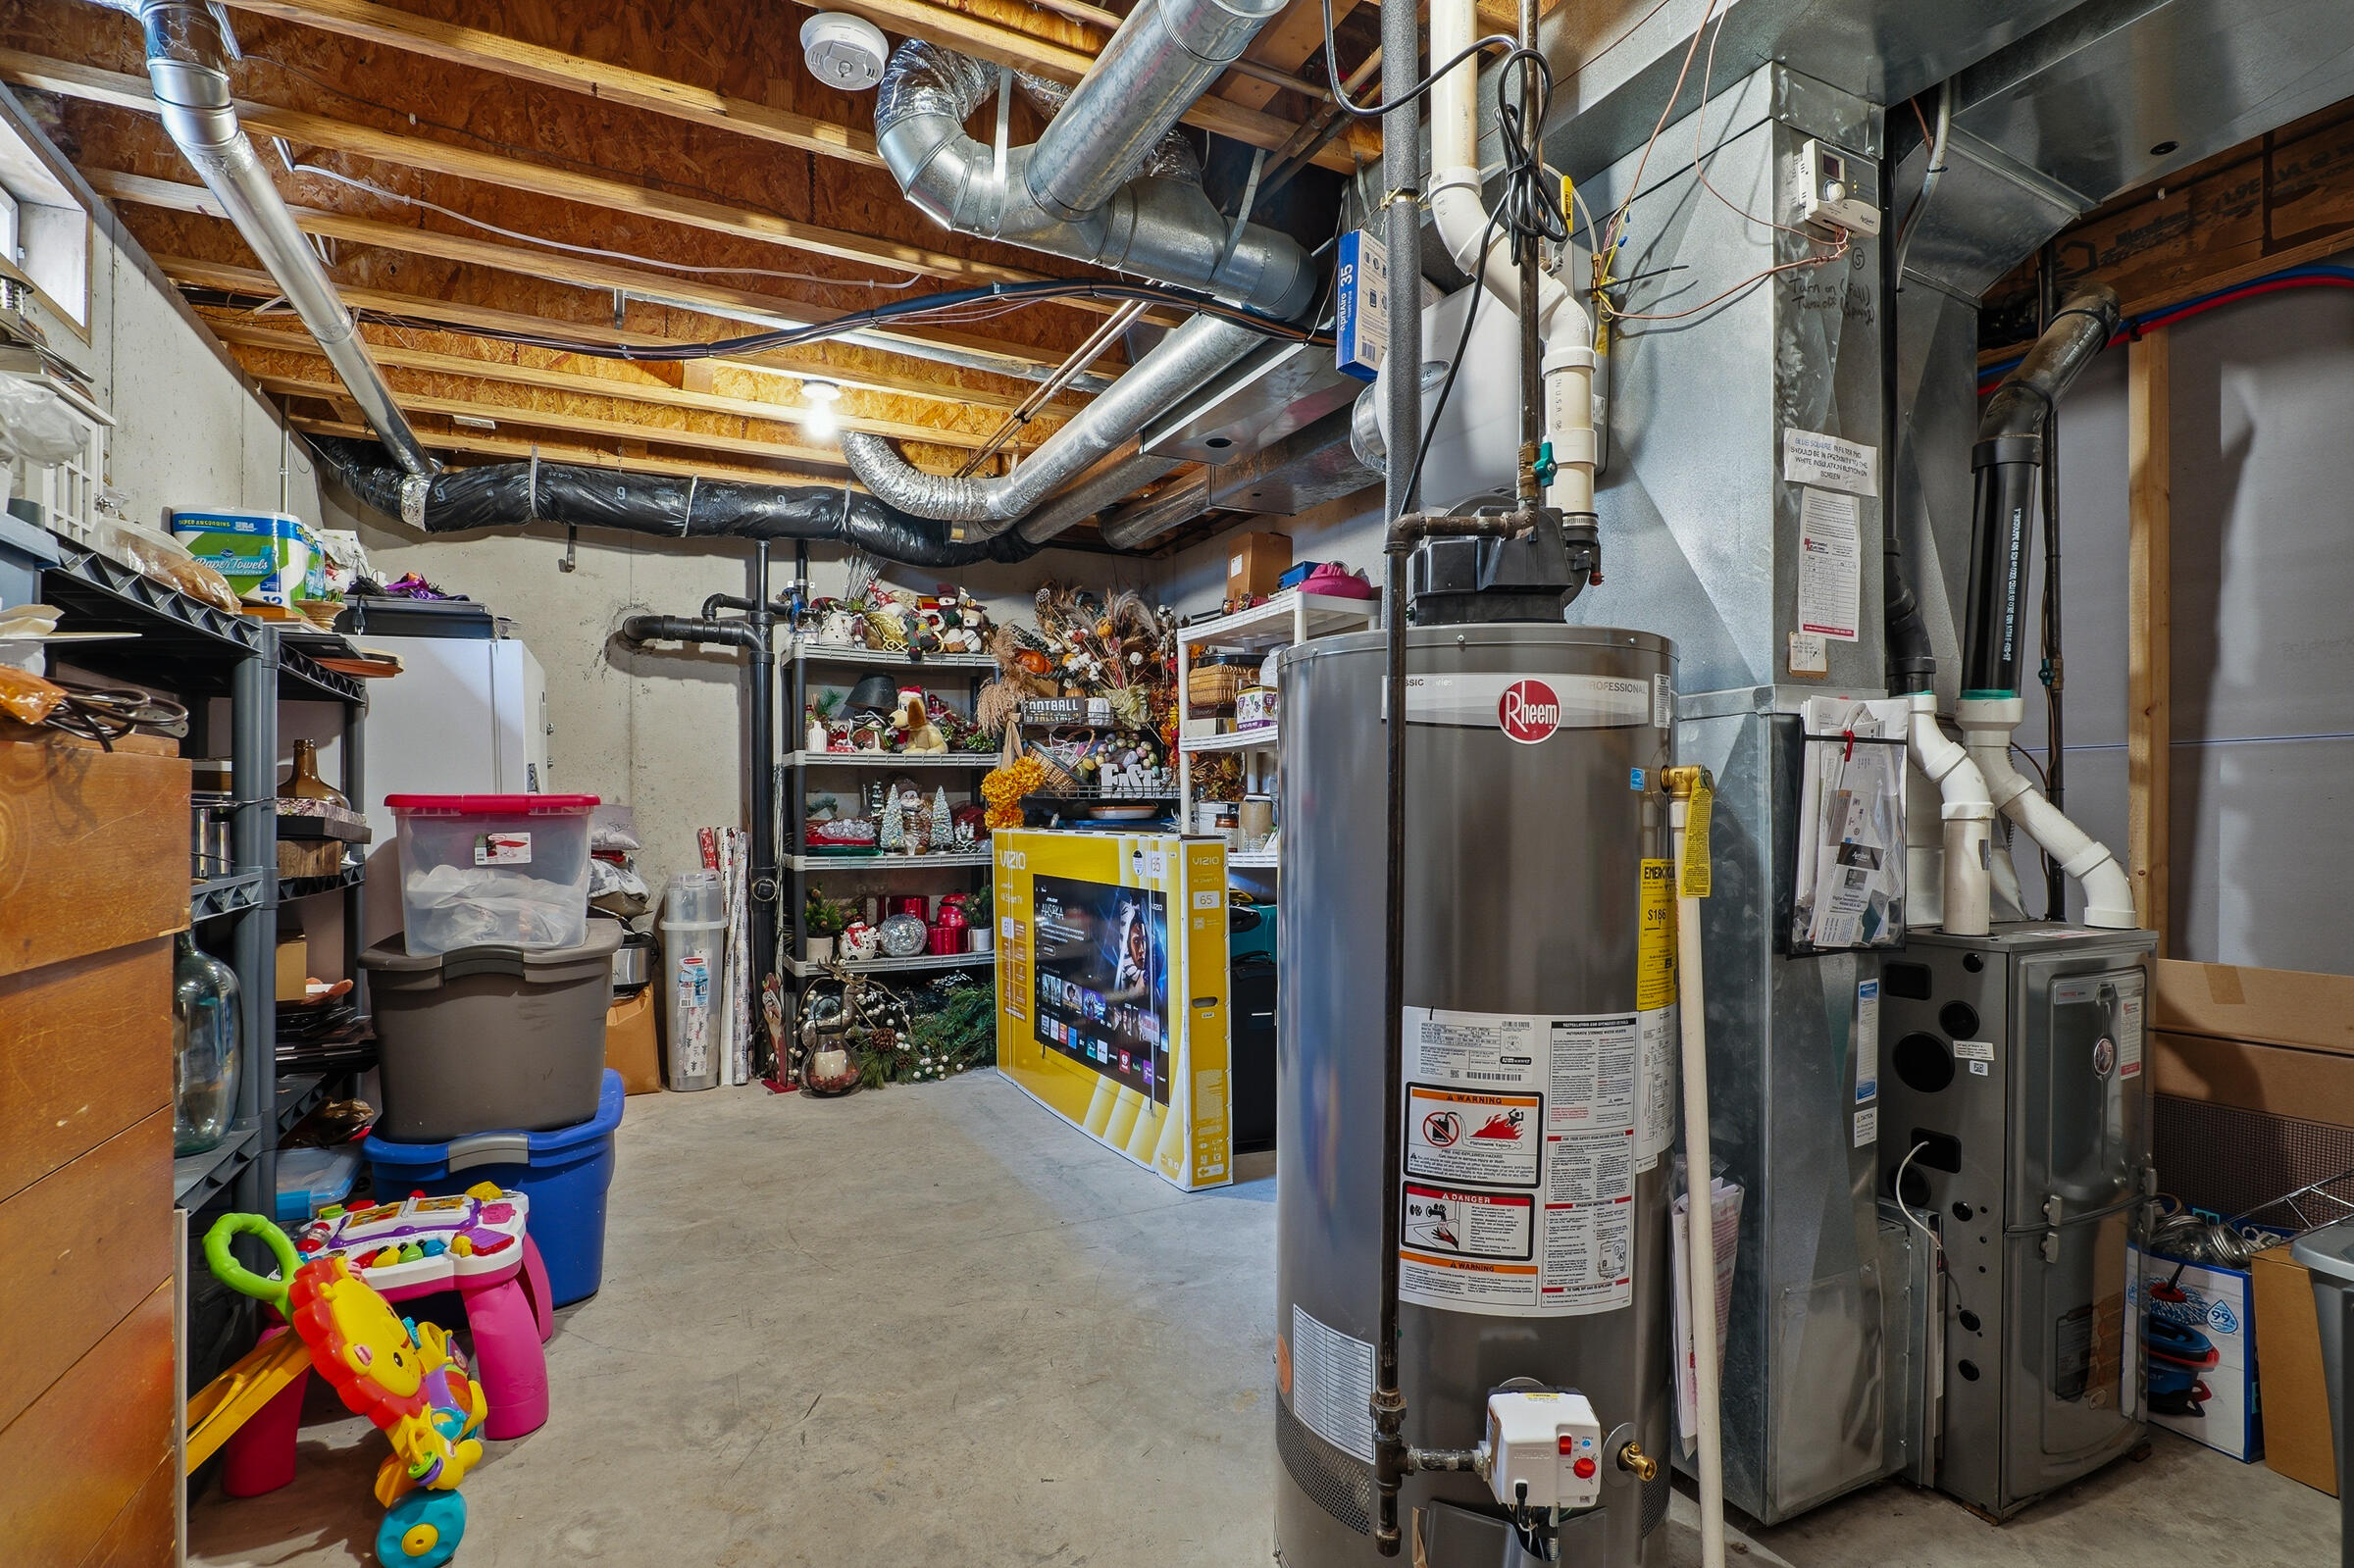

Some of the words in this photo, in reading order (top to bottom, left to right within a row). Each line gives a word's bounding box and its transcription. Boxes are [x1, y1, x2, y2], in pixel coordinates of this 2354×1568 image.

[1340, 264, 1354, 287] 35
[1788, 278, 1820, 293] Turn
[1824, 284, 1837, 295] on
[1794, 437, 1810, 447] BLUE
[1810, 439, 1832, 451] SQUARE
[1790, 446, 1813, 457] SHOULD
[1794, 456, 1813, 466] WHITE
[1820, 470, 1841, 481] SCREEN
[232, 558, 269, 571] Towels
[1505, 681, 1558, 733] Rheem
[999, 849, 1026, 870] VIZIO
[1192, 856, 1220, 866] VIZIO
[1200, 894, 1213, 905] 65
[1457, 1094, 1503, 1105] WARNING
[1452, 1193, 1491, 1204] DANGER
[1458, 1261, 1495, 1273] WARNING
[2211, 1310, 2231, 1323] 99
